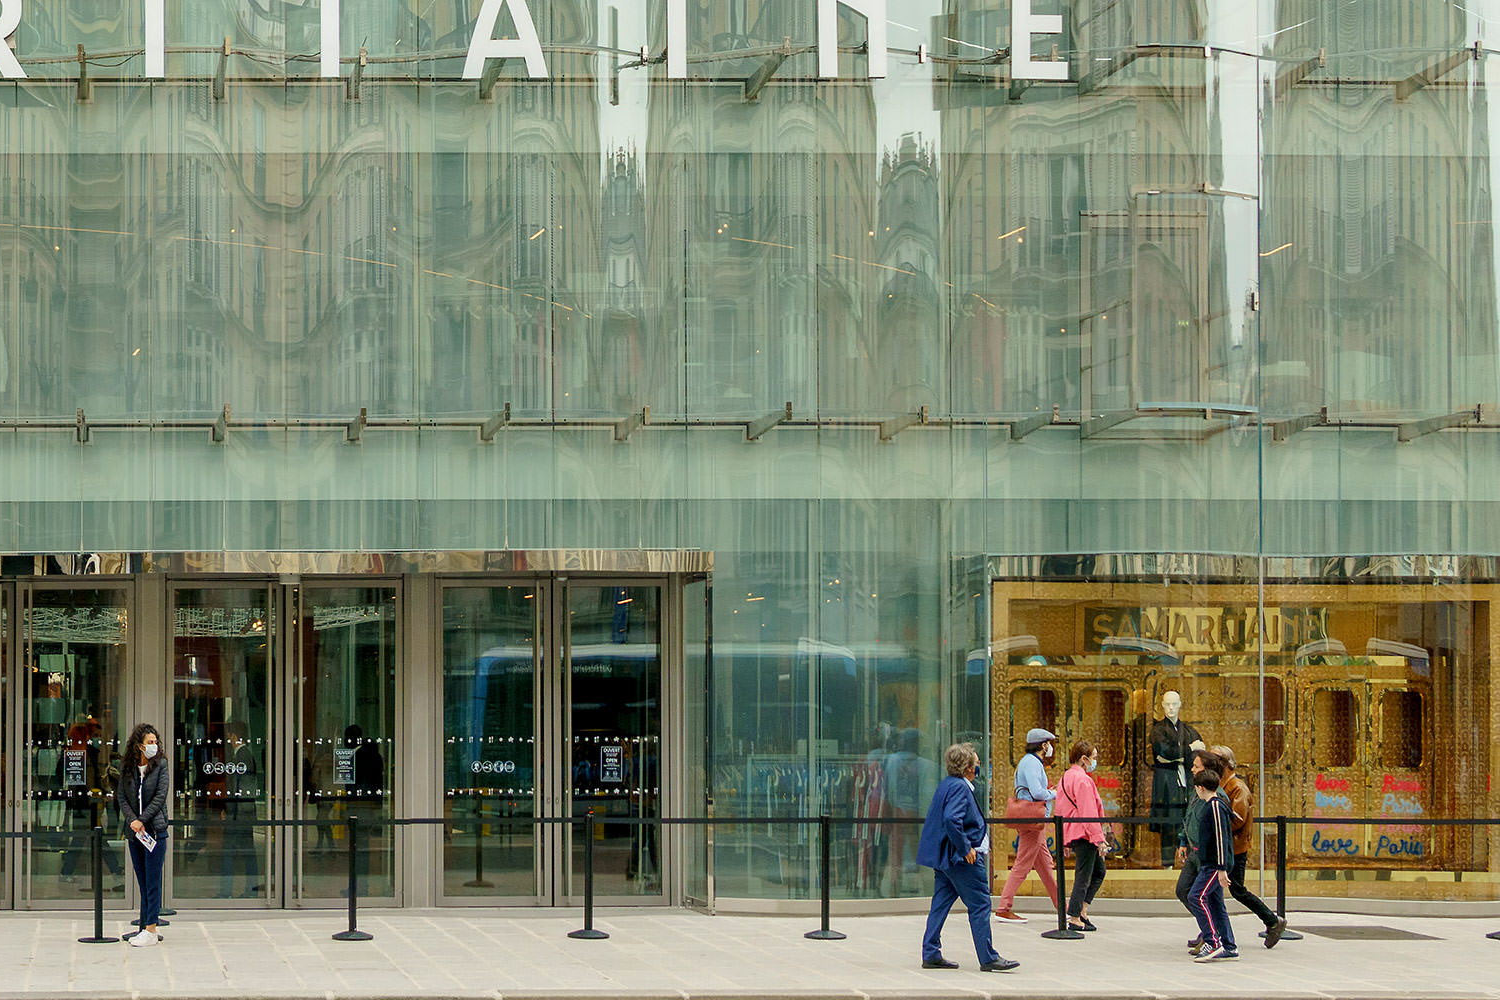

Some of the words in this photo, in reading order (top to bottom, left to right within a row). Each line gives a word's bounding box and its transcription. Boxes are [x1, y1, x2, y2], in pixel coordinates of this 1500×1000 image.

[1092, 613, 1322, 646] SAMARITAINE
[1314, 773, 1350, 791] love
[1381, 774, 1422, 793] Paris
[1315, 791, 1352, 811] love
[1381, 793, 1424, 815] Paris
[1311, 830, 1359, 855] love
[1374, 835, 1423, 857] Paris
